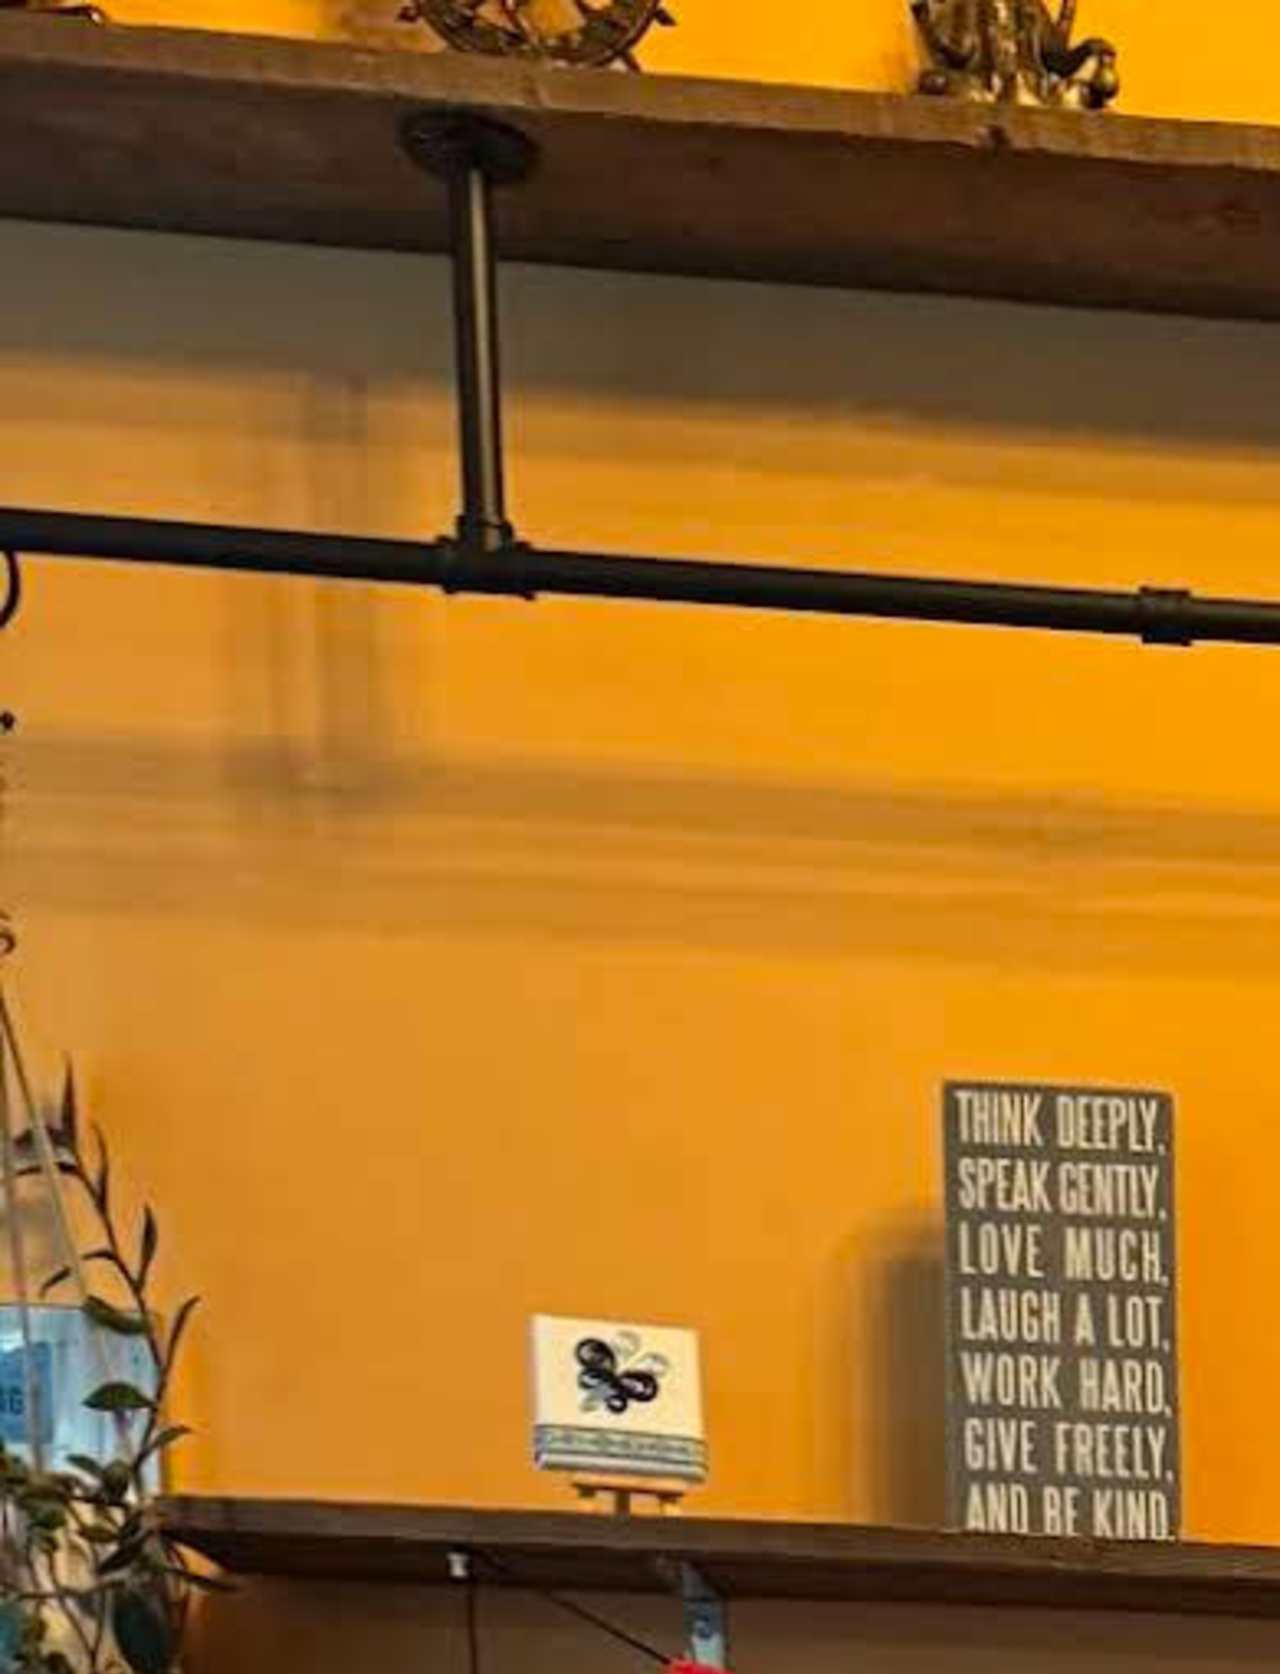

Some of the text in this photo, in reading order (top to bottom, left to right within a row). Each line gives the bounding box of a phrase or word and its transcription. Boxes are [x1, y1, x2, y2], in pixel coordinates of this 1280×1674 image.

[953, 1089, 1166, 1156] THINK DEEPLY,
[957, 1156, 1168, 1221] SPEAK GENTLY,
[958, 1221, 1169, 1287] LOVE MUCH,
[960, 1286, 1170, 1354] LAUGH A LOT,
[961, 1351, 1173, 1419] WORK HARD,
[964, 1416, 1175, 1482] GIVE FREELY,
[965, 1482, 1176, 1541] AND BE KIND.
